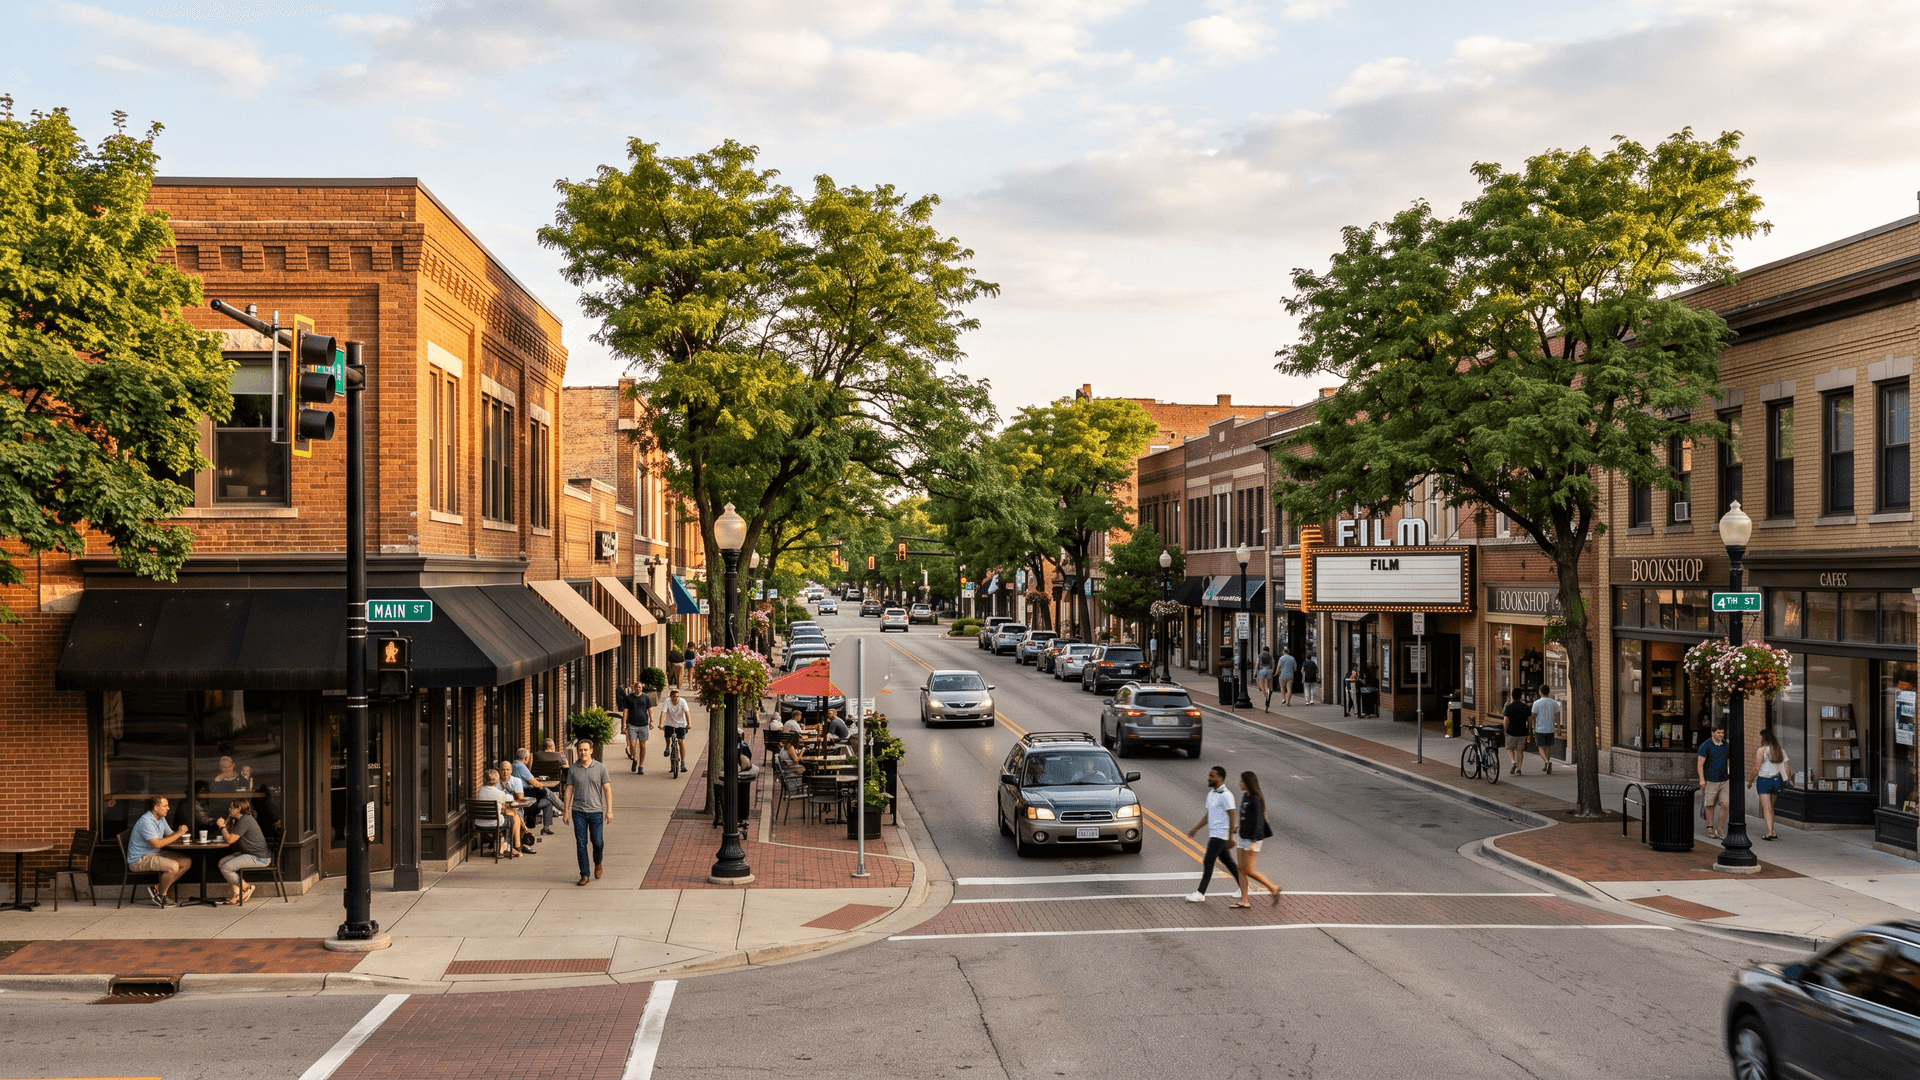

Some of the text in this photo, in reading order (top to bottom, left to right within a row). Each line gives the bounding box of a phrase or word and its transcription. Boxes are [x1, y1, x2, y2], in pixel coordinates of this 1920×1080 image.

[1338, 518, 1426, 547] FILM
[1370, 559, 1399, 571] FILM
[1631, 558, 1704, 582] BOOKSHOP
[1717, 596, 1755, 609] 4TH ST
[374, 603, 424, 619] MAIN ST
